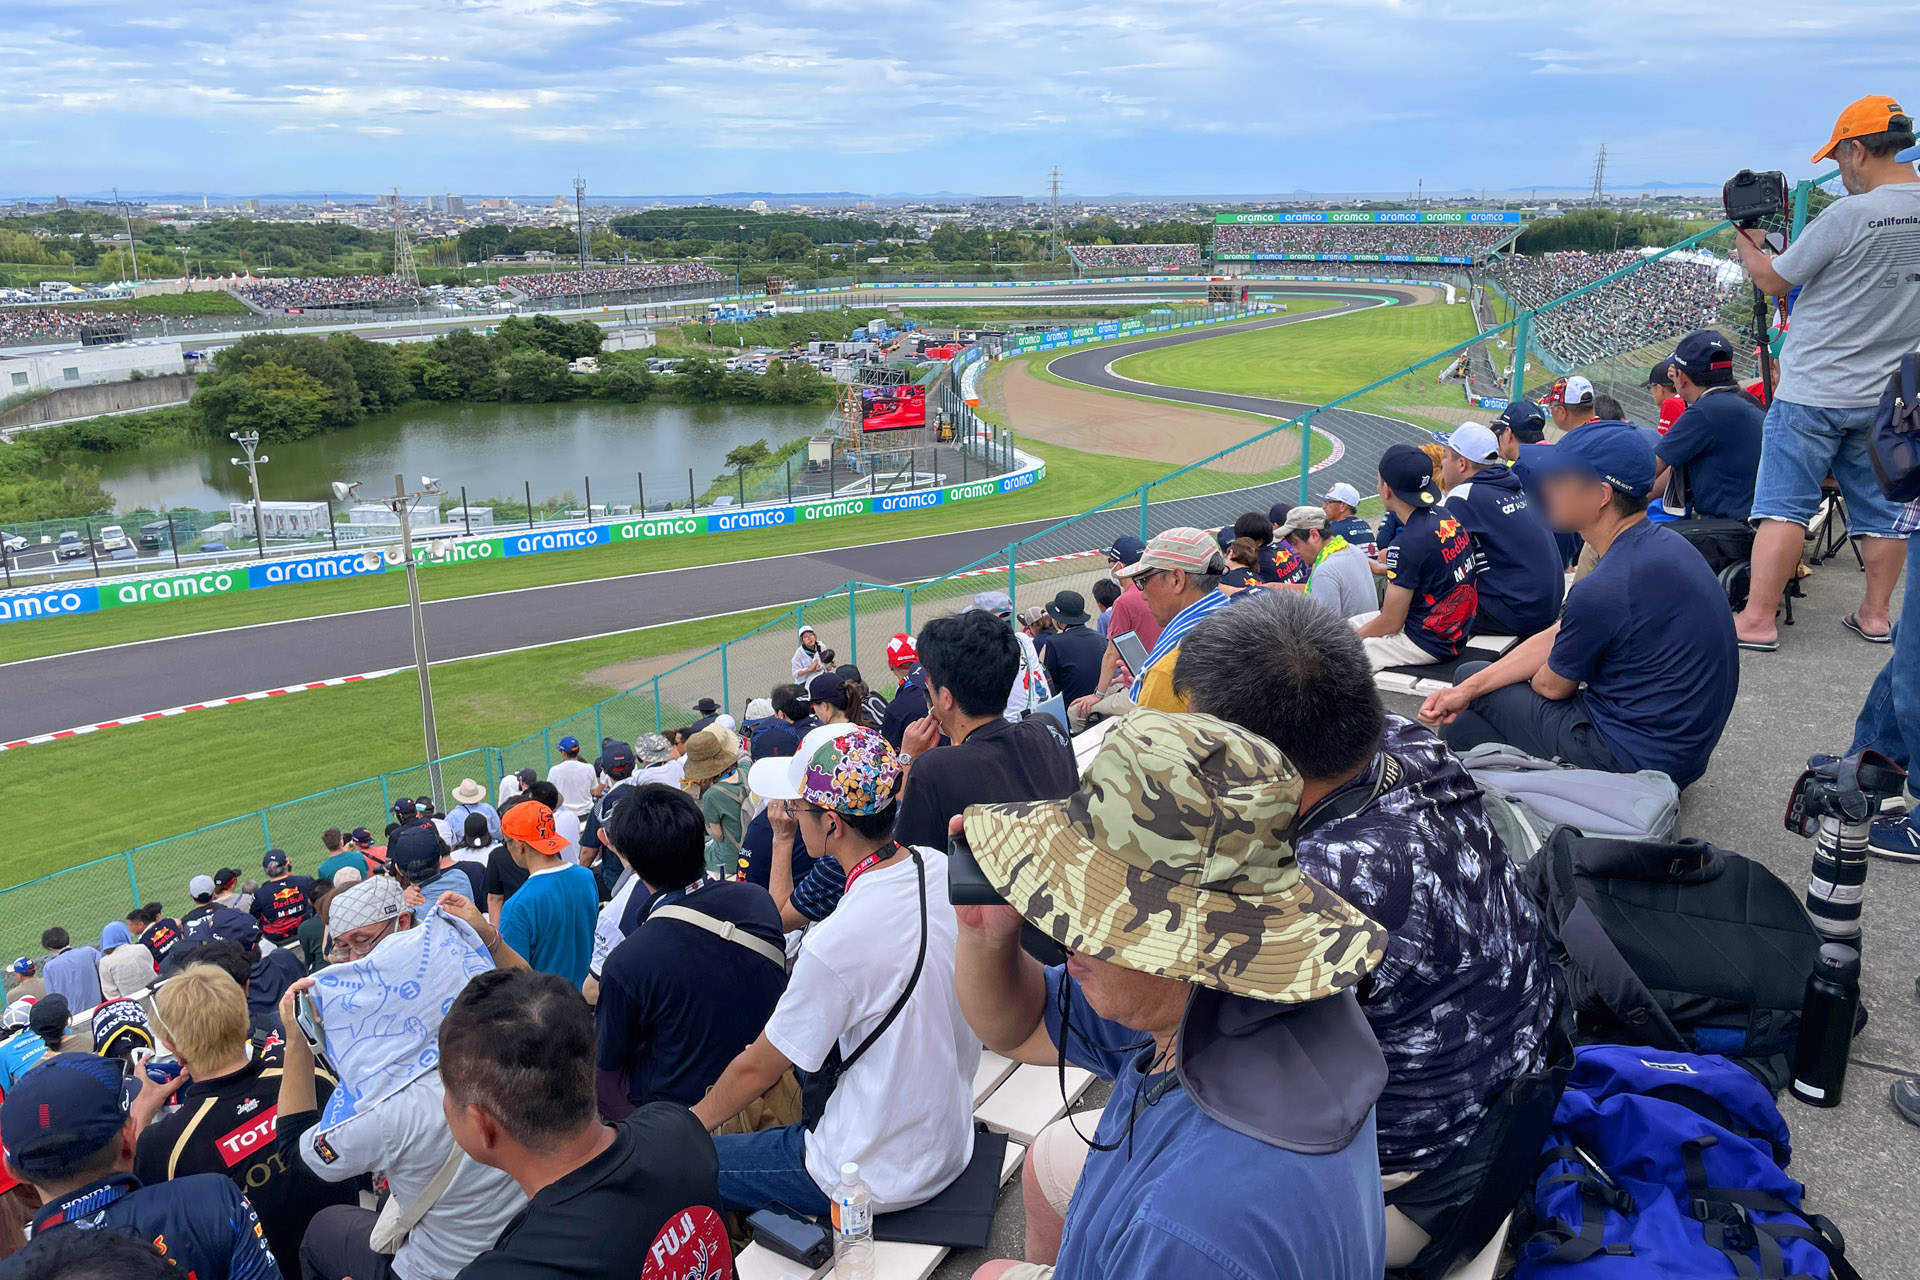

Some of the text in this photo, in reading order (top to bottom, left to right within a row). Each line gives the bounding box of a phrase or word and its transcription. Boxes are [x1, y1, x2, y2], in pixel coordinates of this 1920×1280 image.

[1236, 214, 1274, 222] aramco
[1285, 213, 1322, 221] aramco
[1333, 212, 1370, 220] aramco
[1380, 212, 1416, 220] aramco
[1426, 212, 1462, 221] aramco
[1470, 212, 1504, 221] aramco
[1073, 327, 1094, 337] aramco
[1098, 323, 1118, 333] aramco
[1122, 320, 1140, 330] aramco
[1019, 335, 1040, 345] aramco
[1047, 331, 1068, 341] aramco
[1004, 472, 1033, 490] aramco
[1605, 474, 1634, 491] MAMMUT
[951, 483, 994, 500] aramco
[882, 492, 937, 510] aramco
[805, 500, 864, 520] aramco
[718, 508, 785, 530] aramco
[621, 518, 697, 539] aramco
[517, 528, 598, 553] aramco
[118, 574, 232, 603] aramco
[1790, 793, 1804, 822] EOS
[273, 893, 304, 909] Red Bull
[652, 1212, 696, 1270] FUJI
